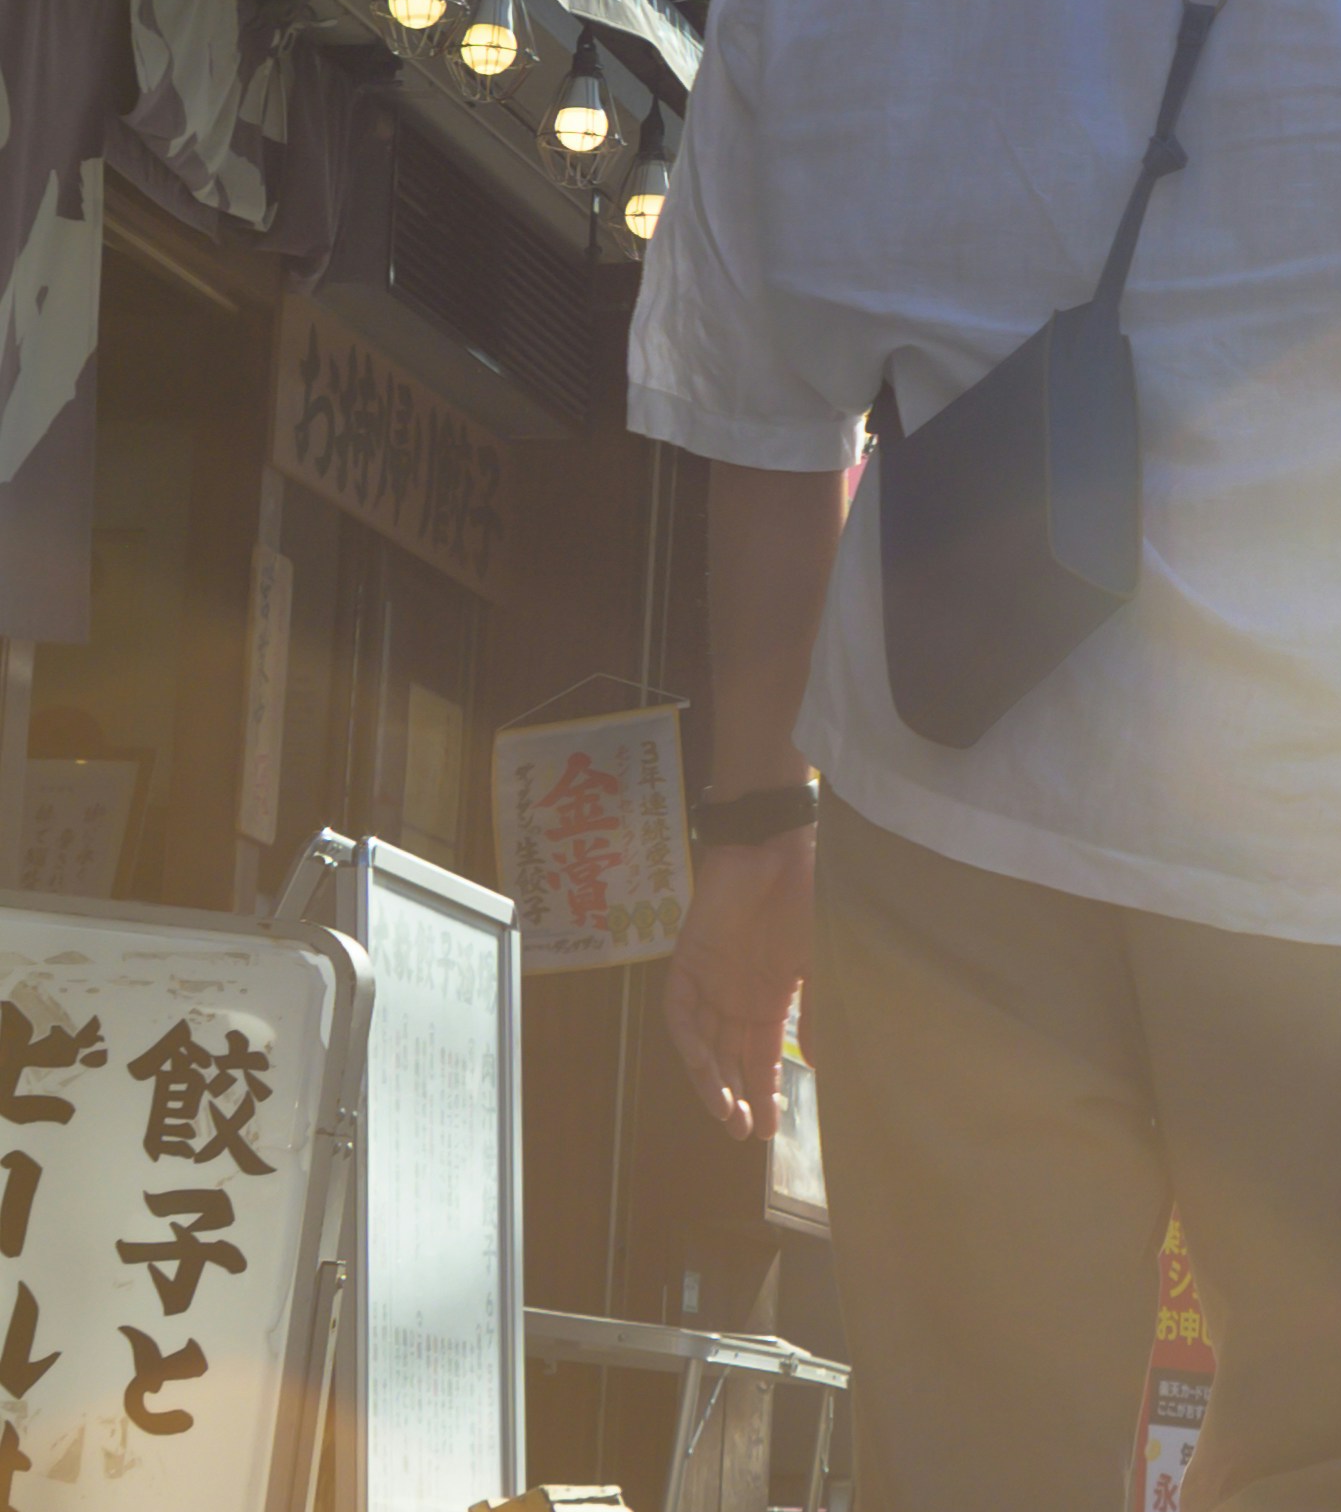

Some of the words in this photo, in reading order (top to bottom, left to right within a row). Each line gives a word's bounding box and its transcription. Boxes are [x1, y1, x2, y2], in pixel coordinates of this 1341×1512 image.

[529, 751, 624, 931] 金賞
[113, 1017, 278, 1436] 餃子と
